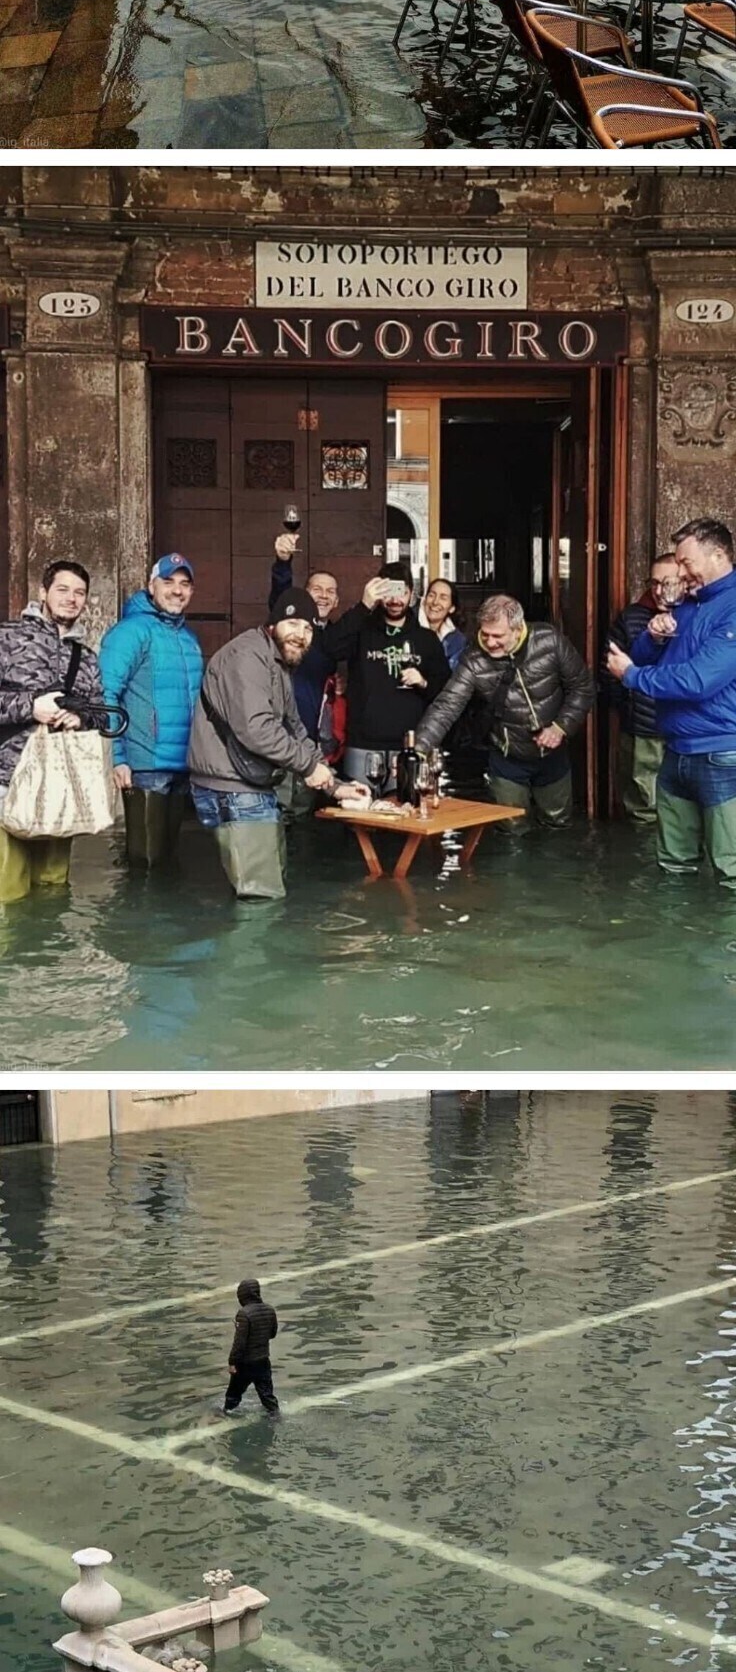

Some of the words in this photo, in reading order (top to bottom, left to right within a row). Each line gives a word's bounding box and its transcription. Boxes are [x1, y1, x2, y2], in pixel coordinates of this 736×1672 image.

[277, 243, 503, 265] SOTOPORTEGO
[266, 276, 324, 297] DEL
[337, 277, 435, 298] BANCO
[445, 278, 519, 298] GIRO
[687, 304, 723, 320] 124
[175, 316, 598, 361] BANCOGIRO
